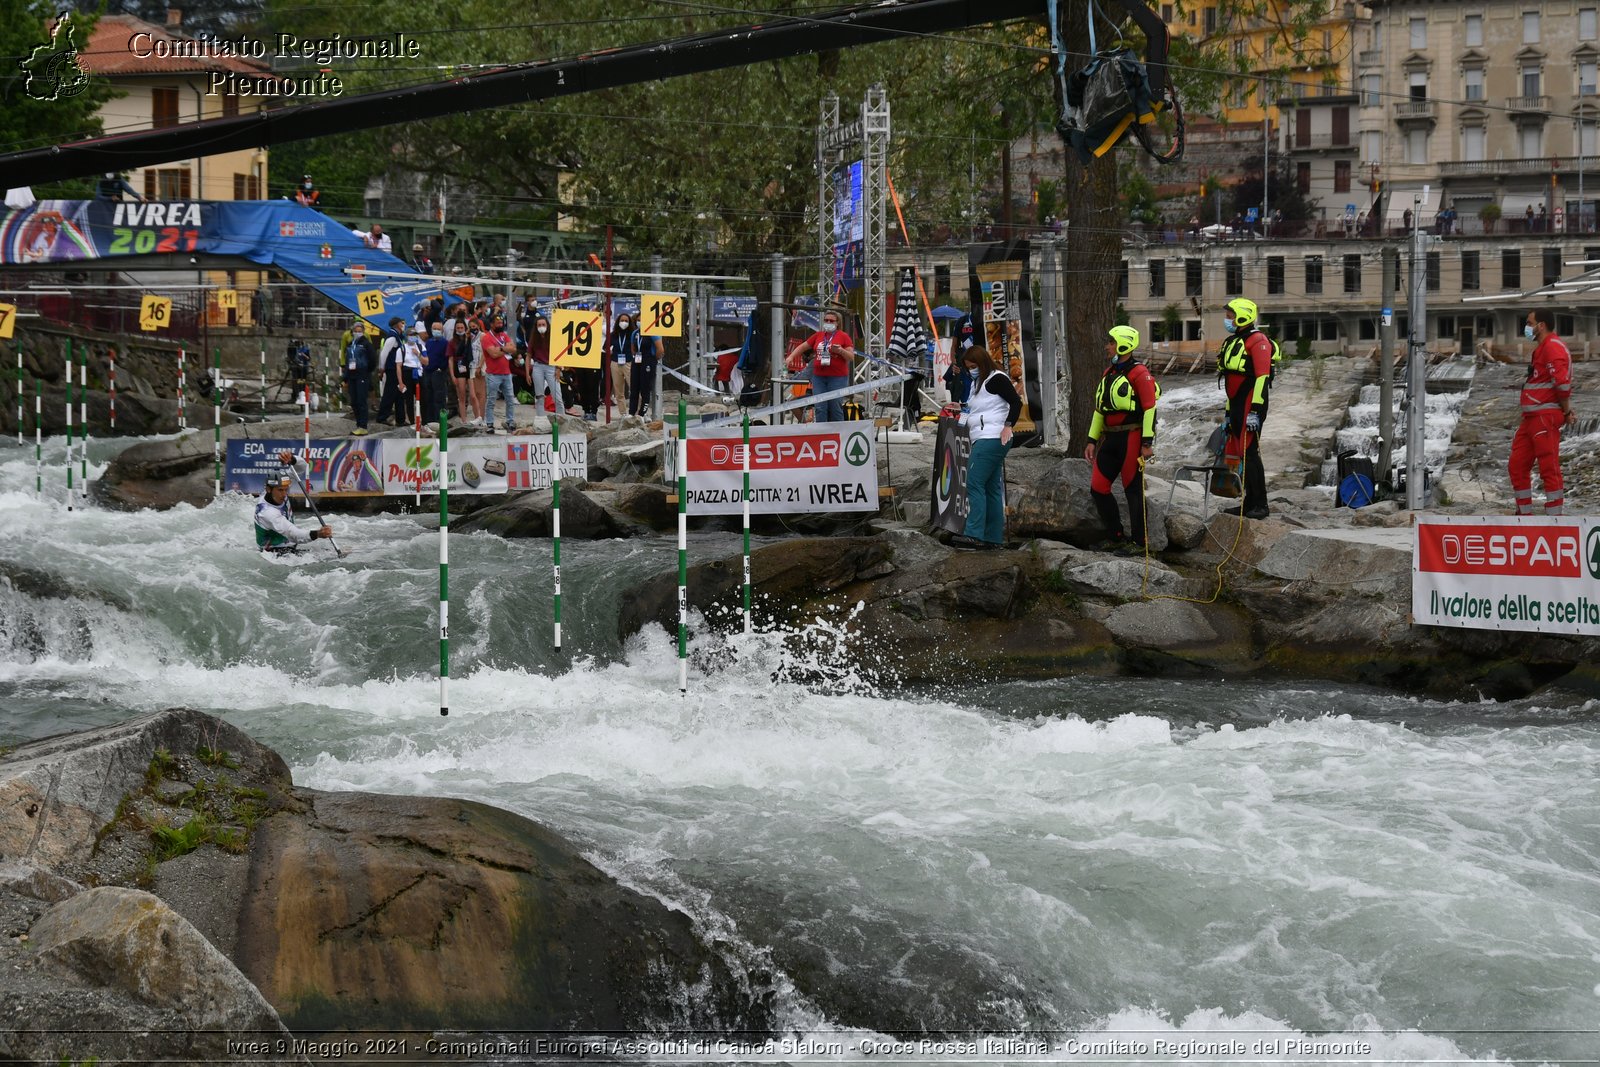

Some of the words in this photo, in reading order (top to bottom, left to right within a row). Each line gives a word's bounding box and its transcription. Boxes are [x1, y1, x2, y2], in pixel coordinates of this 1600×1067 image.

[113, 203, 202, 226] IVREA
[109, 227, 199, 253] 2021
[148, 302, 166, 321] 16
[363, 295, 379, 310] 15
[992, 281, 1006, 320] KIND
[650, 300, 676, 329] 18
[561, 320, 593, 357] 19
[244, 443, 265, 454] ECA
[531, 442, 584, 465] REGONE
[710, 440, 839, 465] DESPAR
[686, 490, 728, 503] PIAZZA
[787, 487, 800, 502] 21
[809, 483, 868, 505] IVREA
[1442, 534, 1578, 567] DESPAR
[1430, 590, 1439, 615] Il
[1442, 592, 1492, 619] valore
[1498, 594, 1541, 621] della
[1547, 597, 1600, 625] scelta
